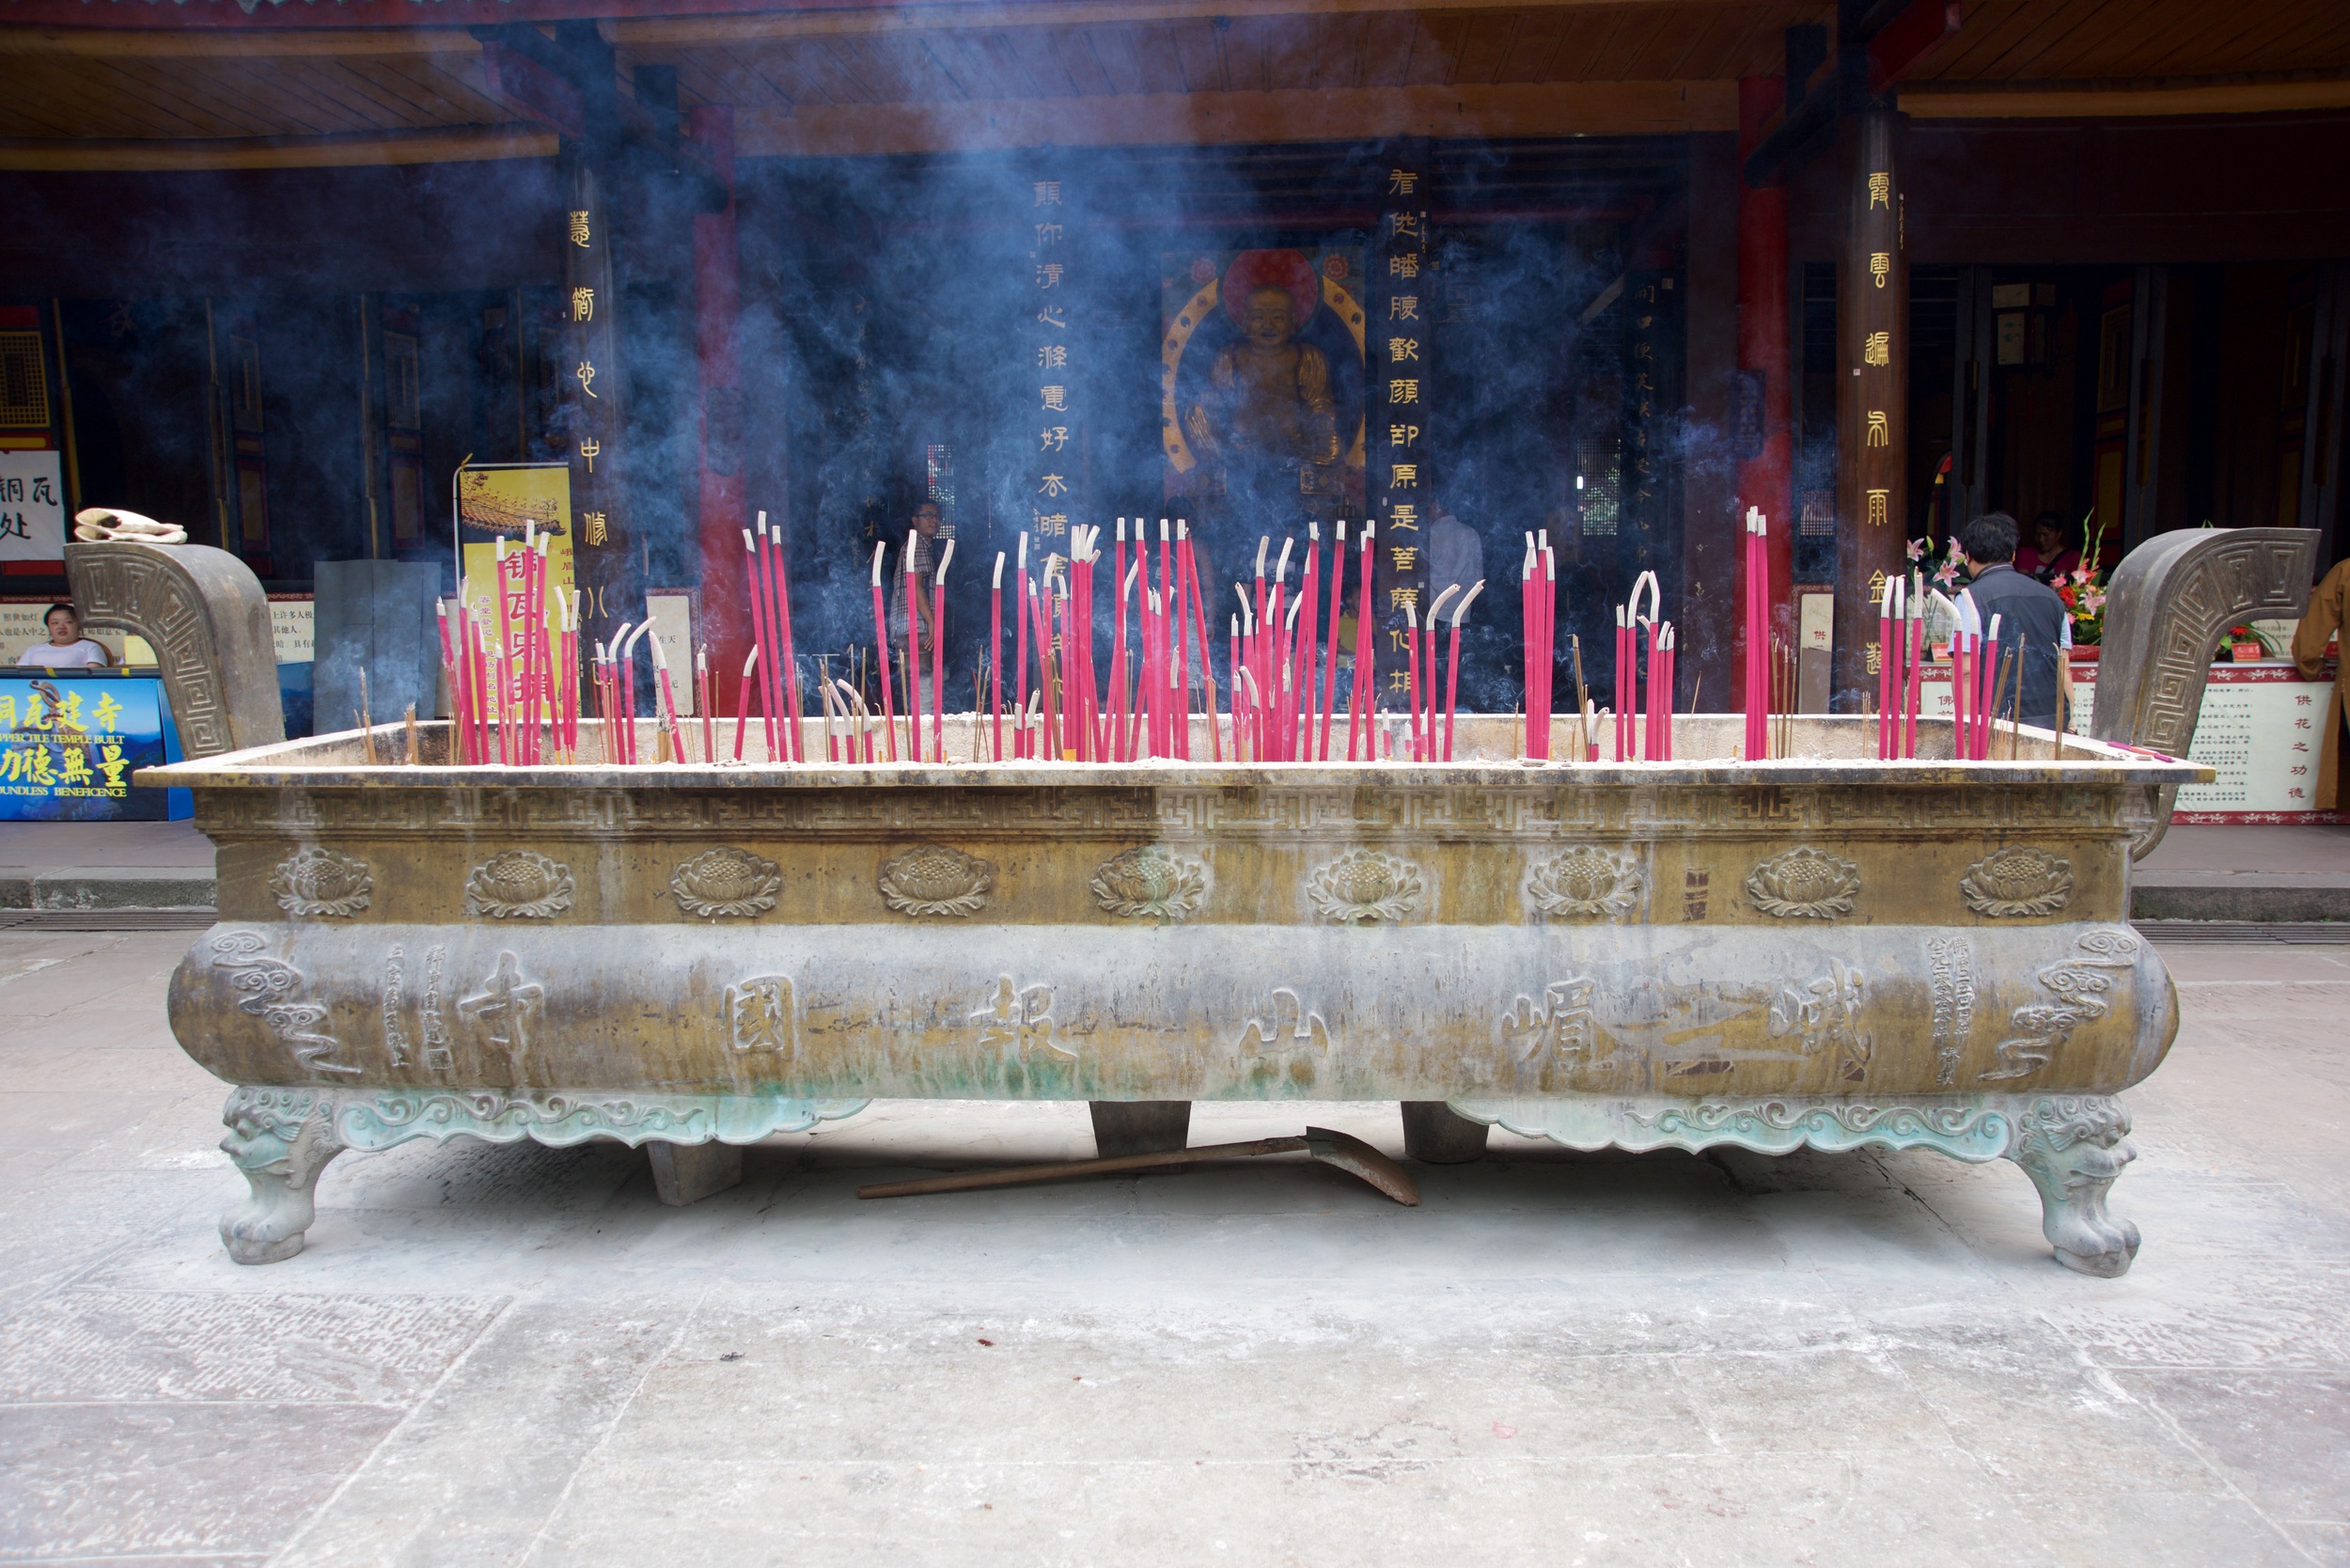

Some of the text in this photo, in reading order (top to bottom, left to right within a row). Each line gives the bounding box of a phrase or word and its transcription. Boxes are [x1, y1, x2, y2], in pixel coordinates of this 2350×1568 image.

[27, 733, 50, 744] TILE
[51, 734, 92, 745] TEMPLE
[95, 735, 126, 745] BUILT
[2288, 694, 2312, 799] 供花之功德
[54, 787, 128, 797] BENEFICENCE
